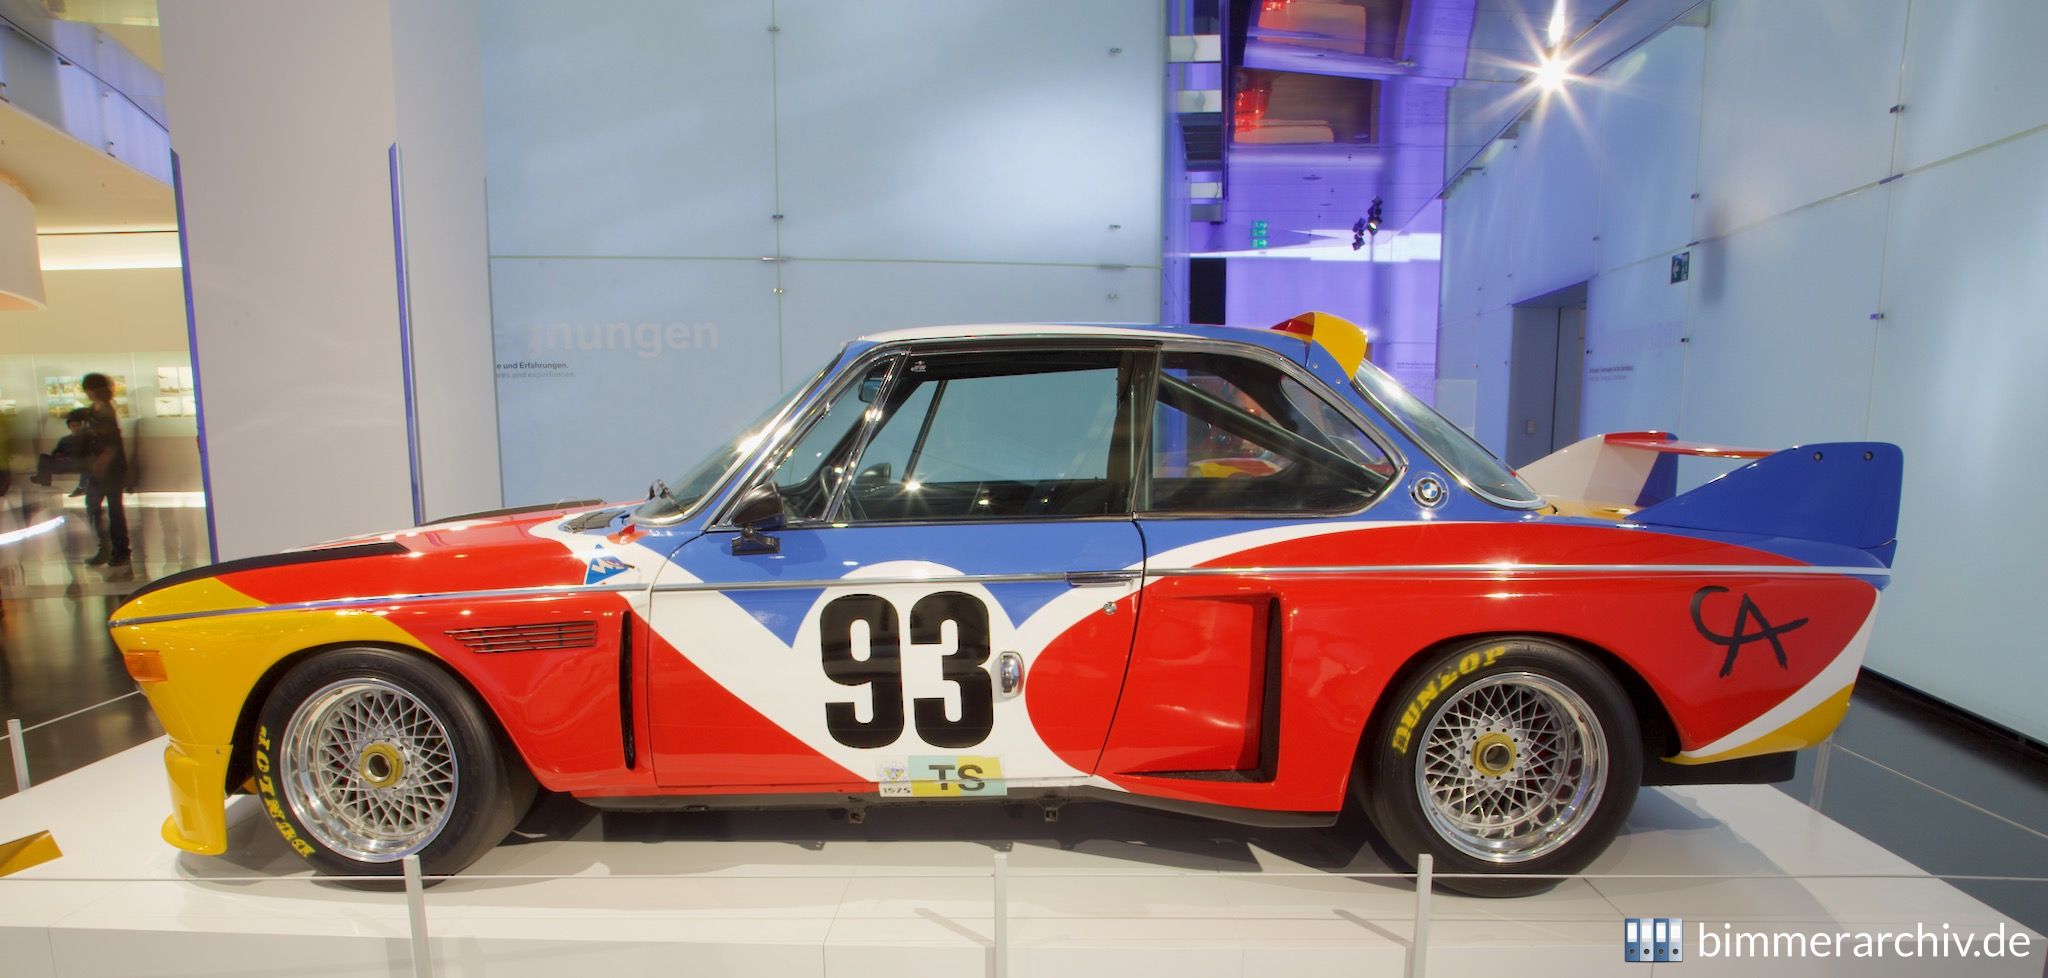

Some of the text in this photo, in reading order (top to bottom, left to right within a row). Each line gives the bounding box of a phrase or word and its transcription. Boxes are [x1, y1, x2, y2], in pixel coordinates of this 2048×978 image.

[503, 361, 518, 370] und
[519, 361, 569, 371] Erfahrungen.
[820, 590, 994, 750] 93
[1690, 585, 1809, 678] CA
[1391, 645, 1505, 754] DUNLOP
[256, 725, 316, 859] DUNLOP
[928, 764, 986, 792] TS
